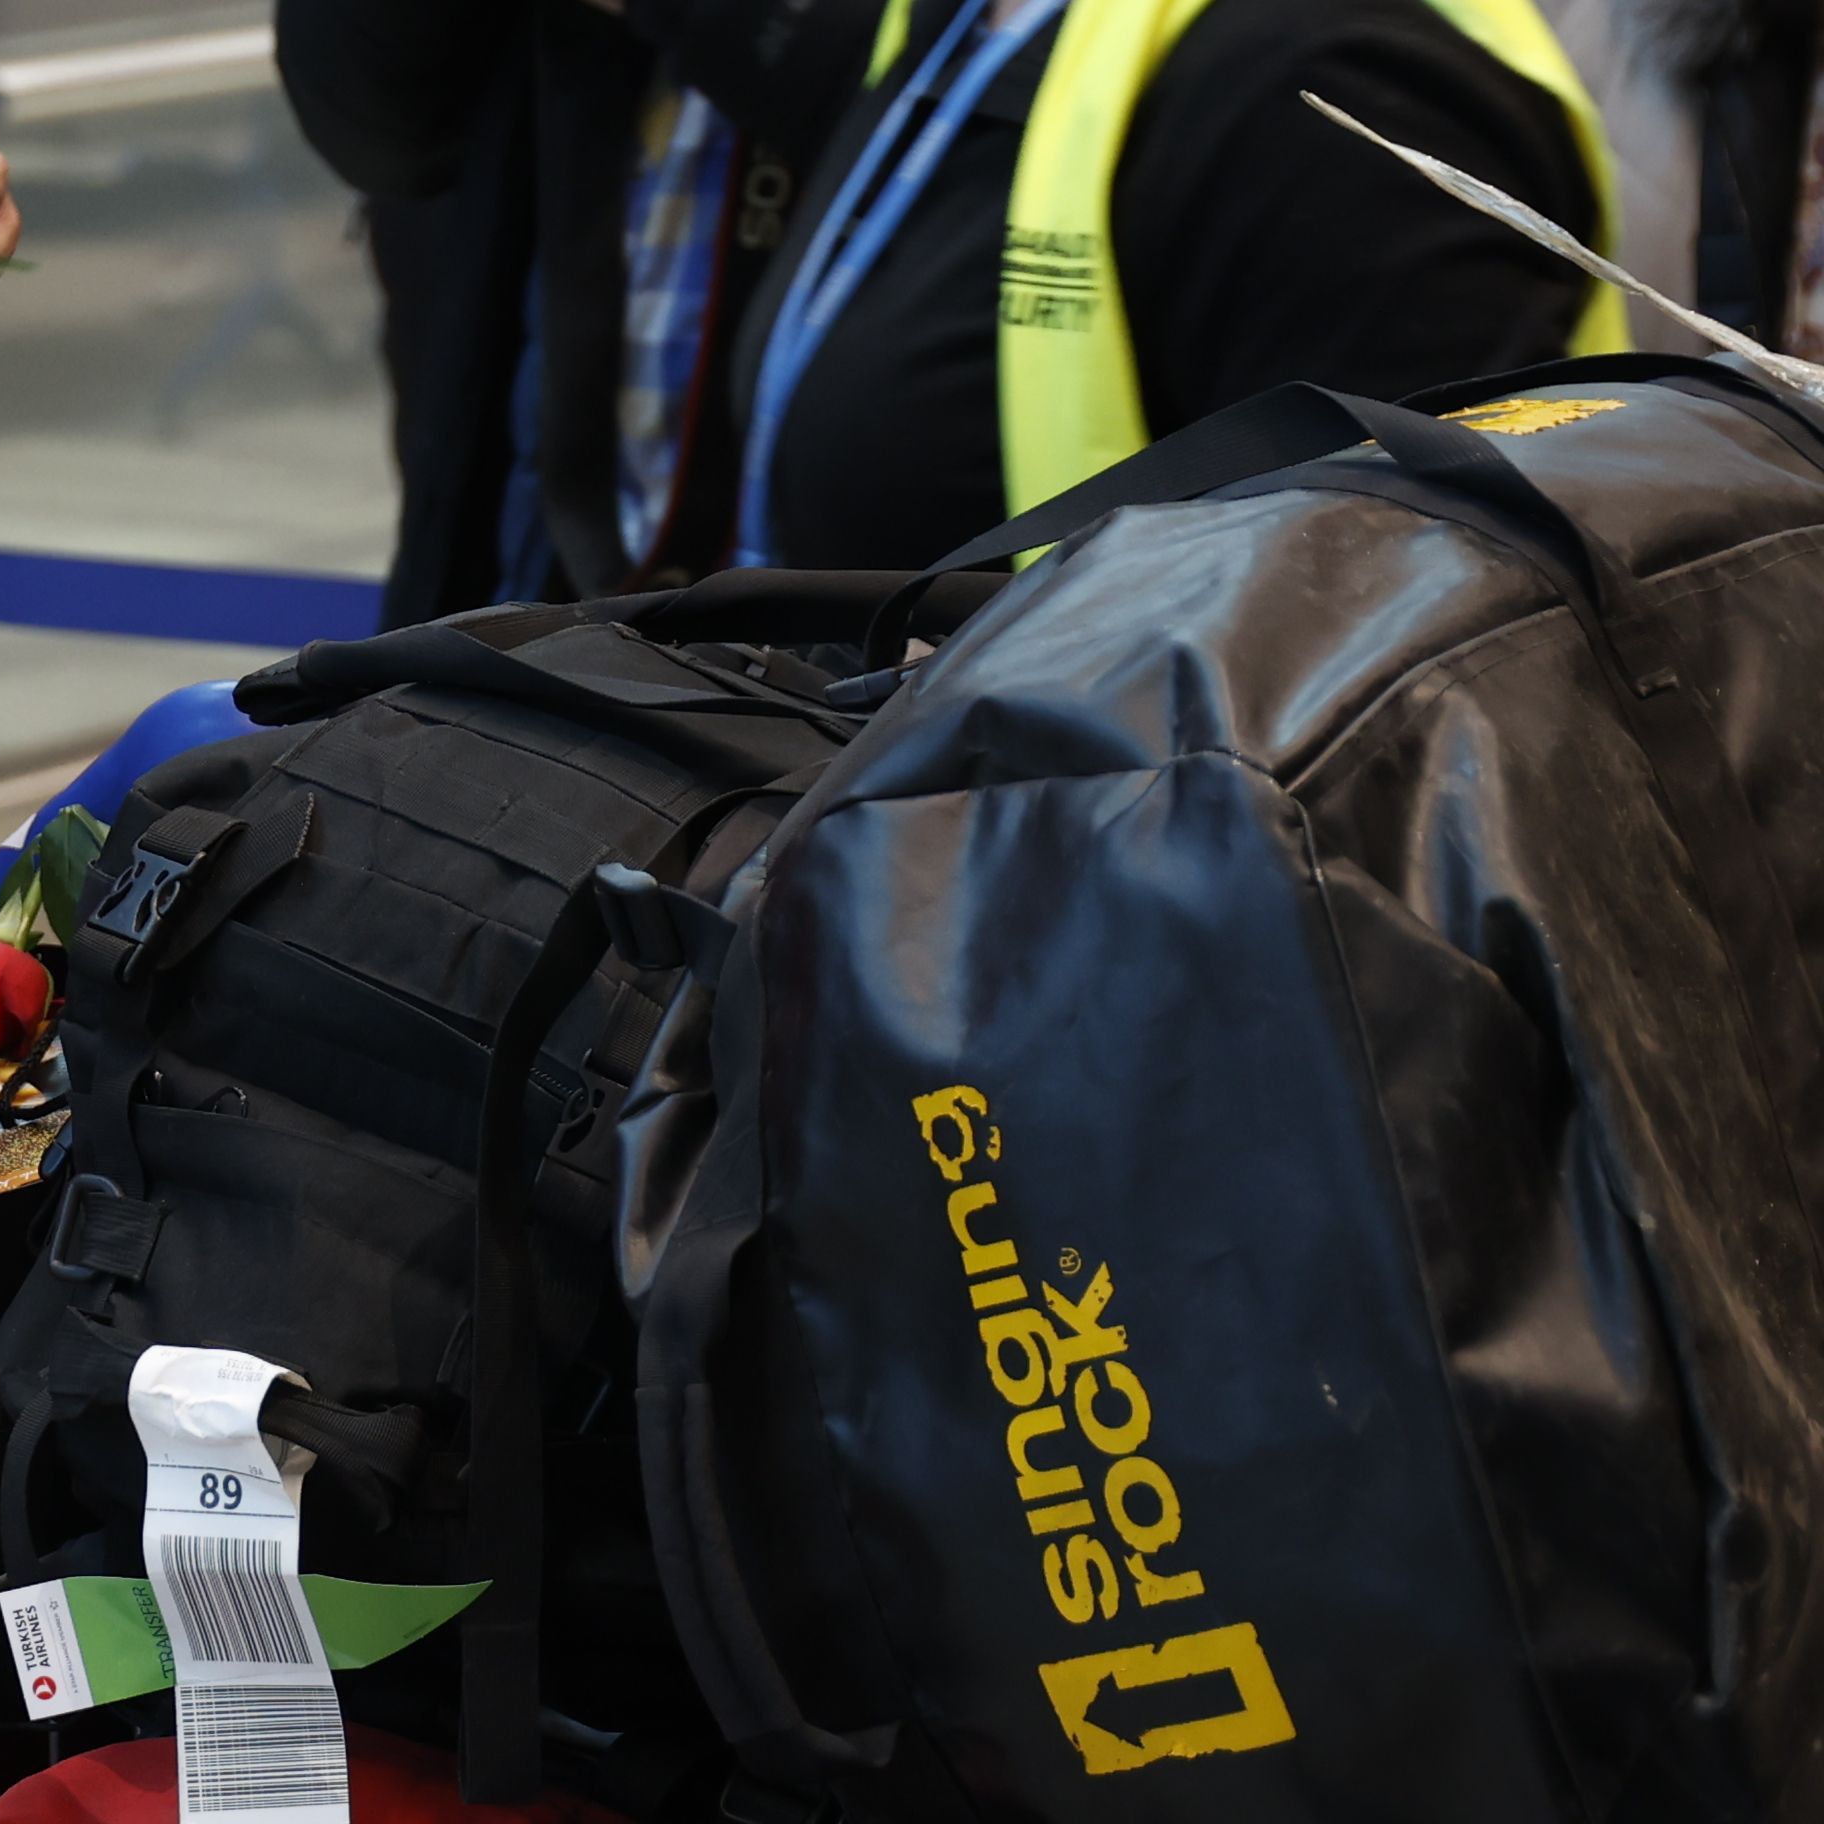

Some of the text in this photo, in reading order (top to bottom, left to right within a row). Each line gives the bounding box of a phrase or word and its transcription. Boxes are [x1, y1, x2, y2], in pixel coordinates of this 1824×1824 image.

[911, 1084, 1120, 1624] singing
[1041, 1261, 1206, 1608] rock
[198, 1472, 244, 1511] 89
[12, 1607, 38, 1672] TURKISH
[24, 1603, 52, 1669] AIRLINES
[132, 1585, 176, 1680] TRANSFER
